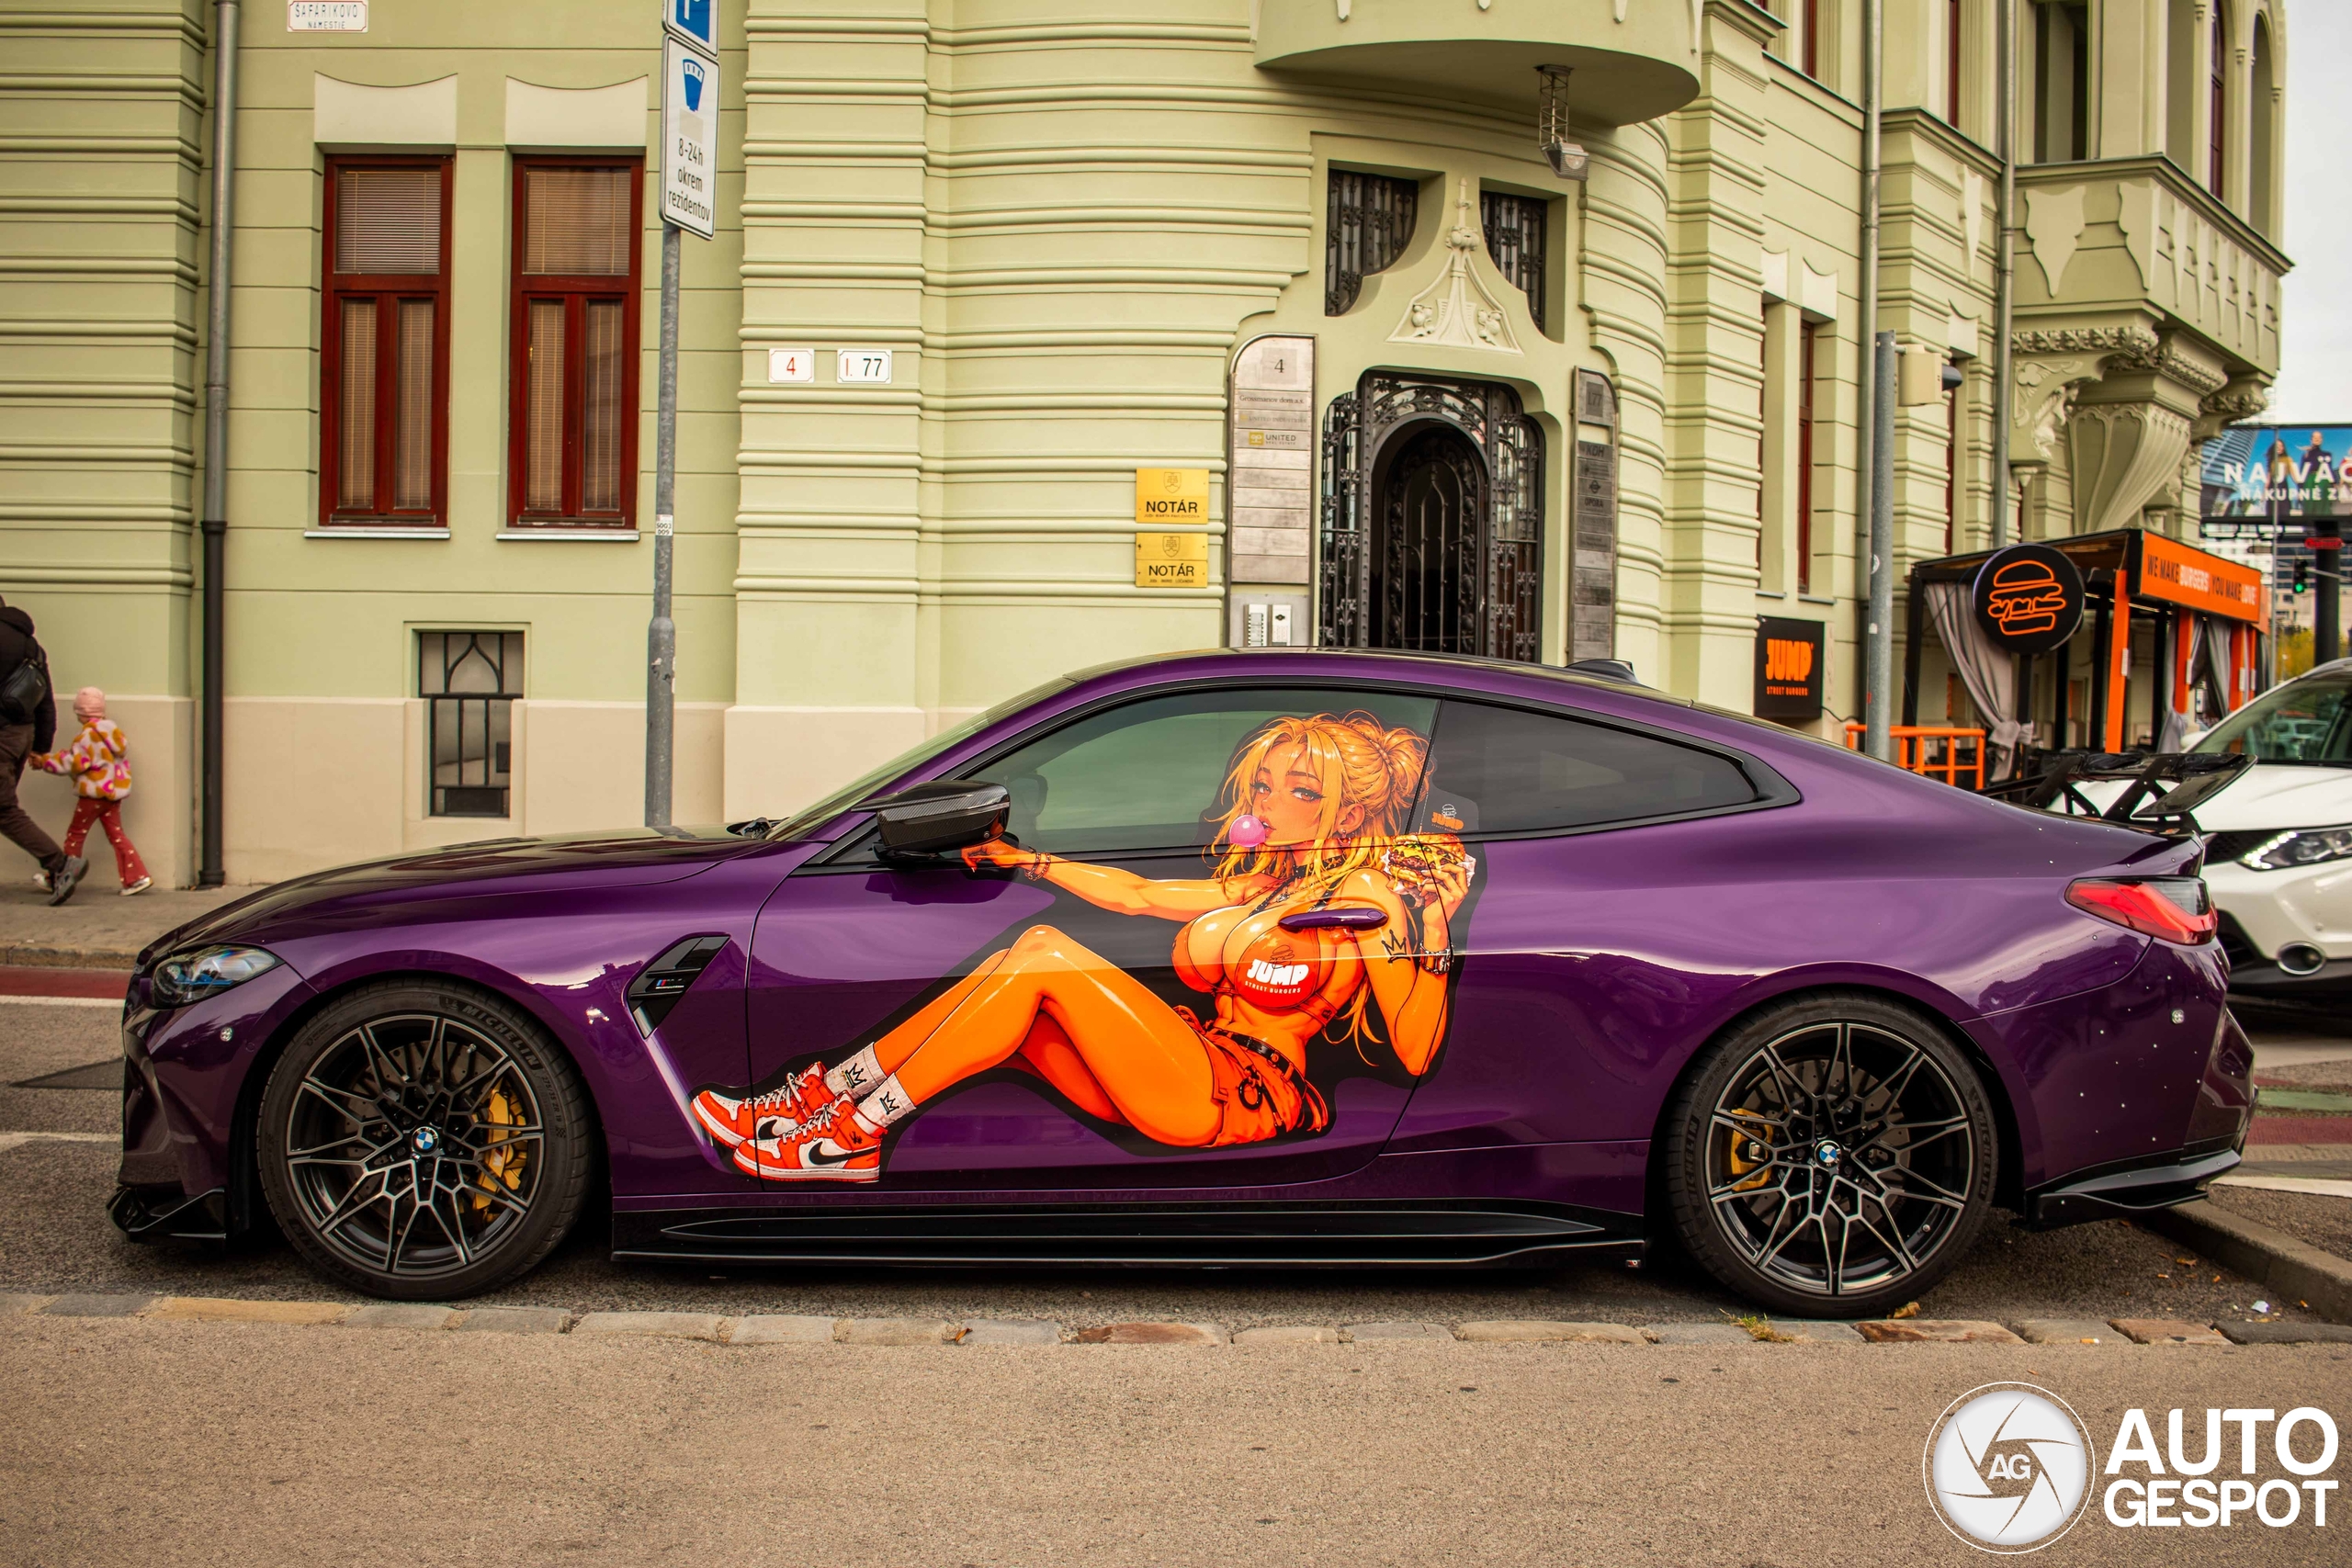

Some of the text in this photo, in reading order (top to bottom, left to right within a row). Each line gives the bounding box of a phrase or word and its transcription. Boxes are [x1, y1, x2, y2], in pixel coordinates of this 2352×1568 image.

[678, 138, 703, 166] 8-24h
[677, 166, 703, 193] okrem
[668, 190, 711, 222] rezidentov
[786, 356, 796, 376] 4
[863, 357, 883, 377] 77
[1274, 358, 1284, 373] 4
[1146, 499, 1198, 513] NOTÁR
[1148, 563, 1194, 576] NOTÁR
[2147, 554, 2158, 577] WE
[2160, 558, 2179, 583] MAKE
[2212, 574, 2224, 596] YOU
[2225, 580, 2242, 602] MAKE
[1765, 638, 1813, 682] JUMP
[1246, 958, 1309, 987] JUMP
[1245, 980, 1268, 992] STREET
[462, 1004, 539, 1066] MICHELIN
[542, 1077, 556, 1100] 275/35
